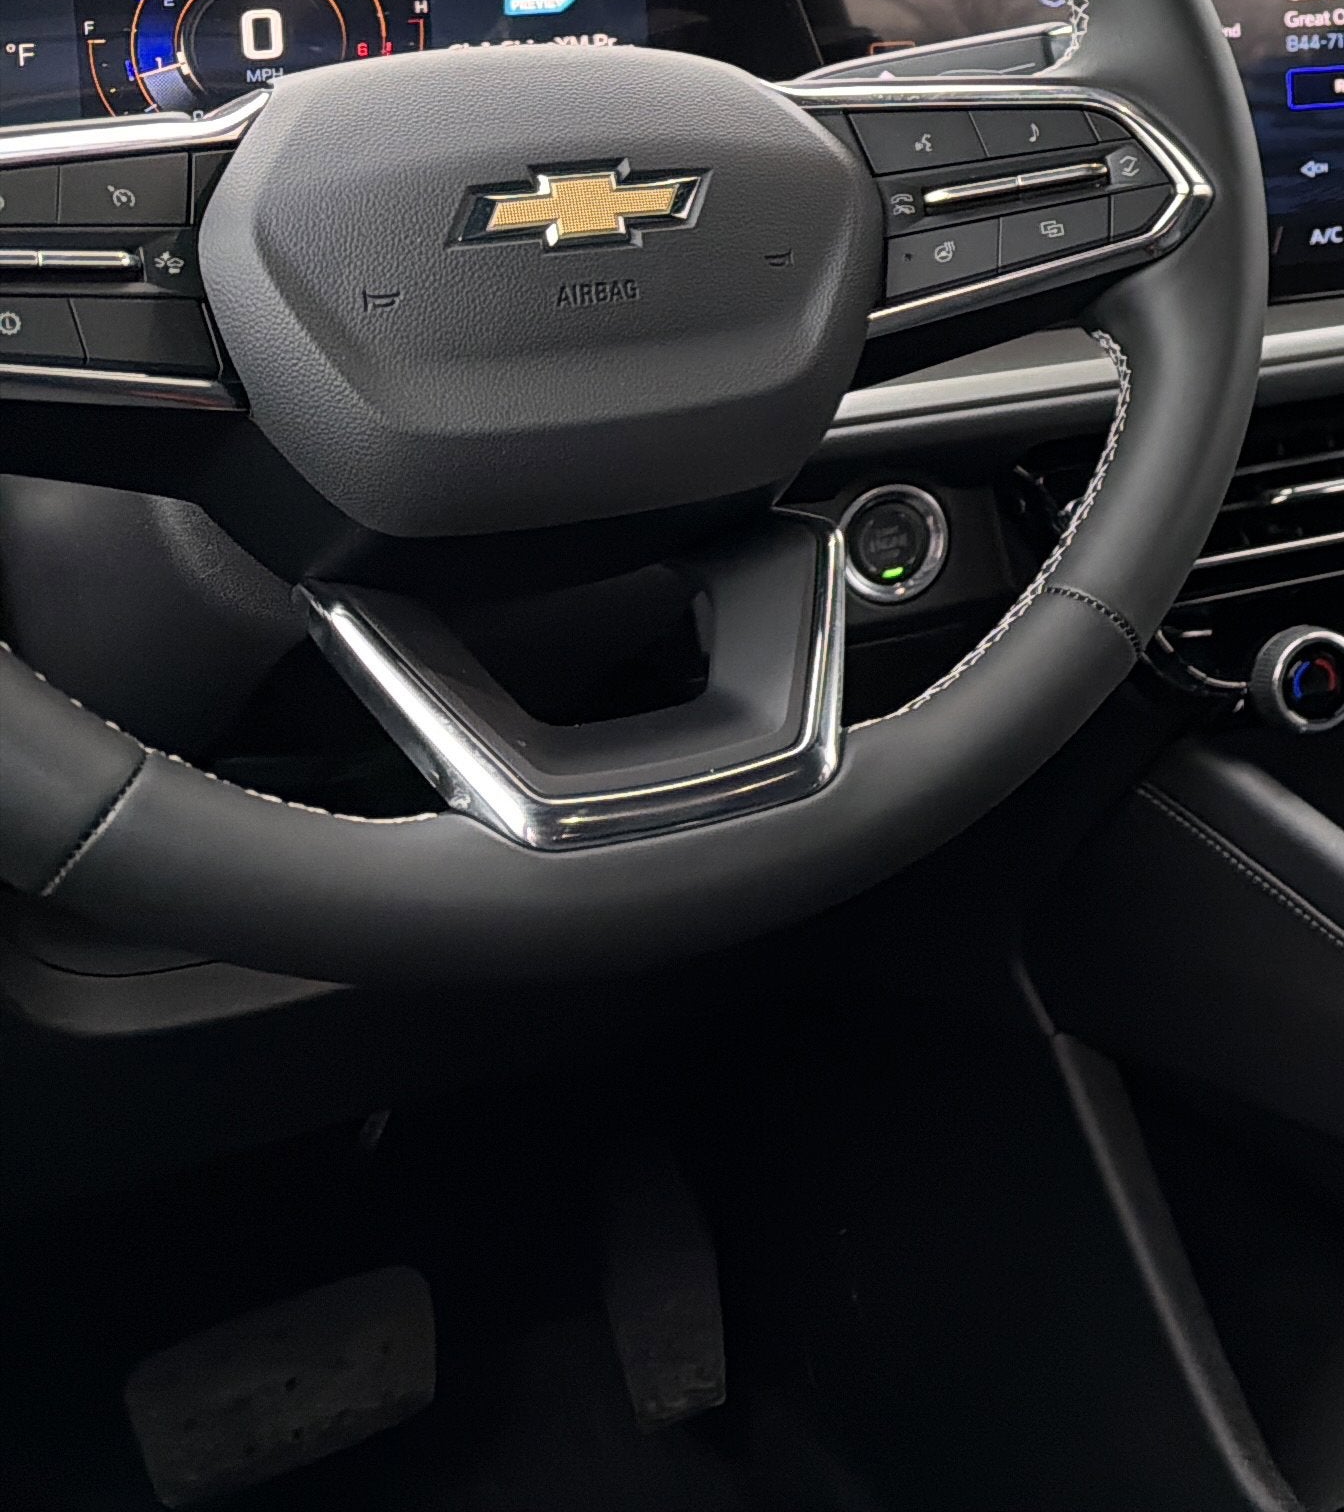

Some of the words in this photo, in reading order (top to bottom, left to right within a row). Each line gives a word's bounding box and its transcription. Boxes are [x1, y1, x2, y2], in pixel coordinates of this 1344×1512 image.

[414, 0, 428, 14] H
[84, 20, 95, 35] F
[1284, 9, 1330, 28] Great
[241, 8, 283, 60] 0
[357, 42, 369, 57] 6
[1309, 226, 1344, 246] A/C
[556, 279, 640, 308] AIRBAG
